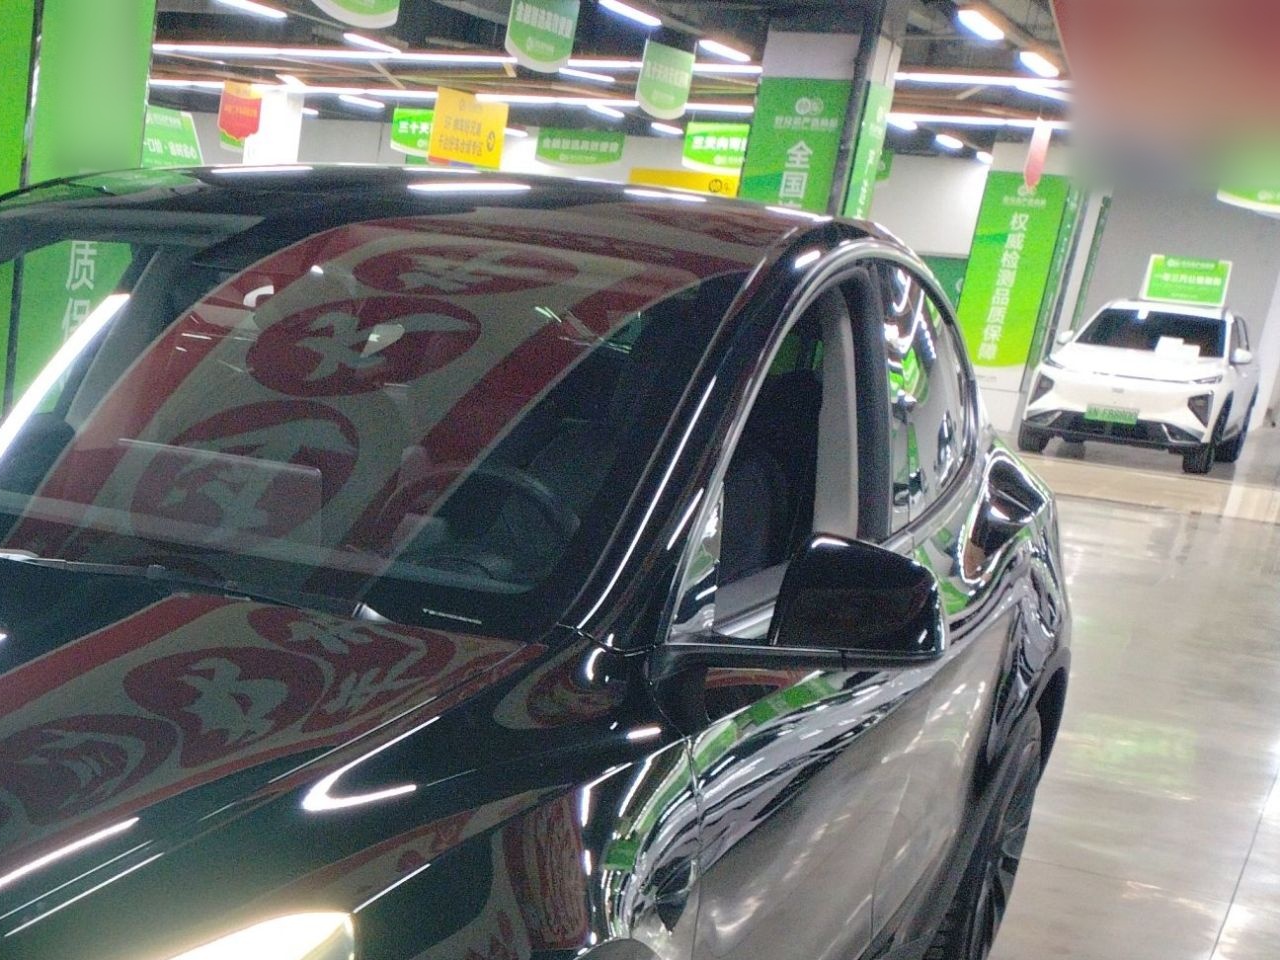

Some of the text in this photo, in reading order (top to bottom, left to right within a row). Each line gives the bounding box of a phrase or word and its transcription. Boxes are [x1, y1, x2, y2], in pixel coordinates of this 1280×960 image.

[977, 211, 1030, 361] 权威检测品质保障
